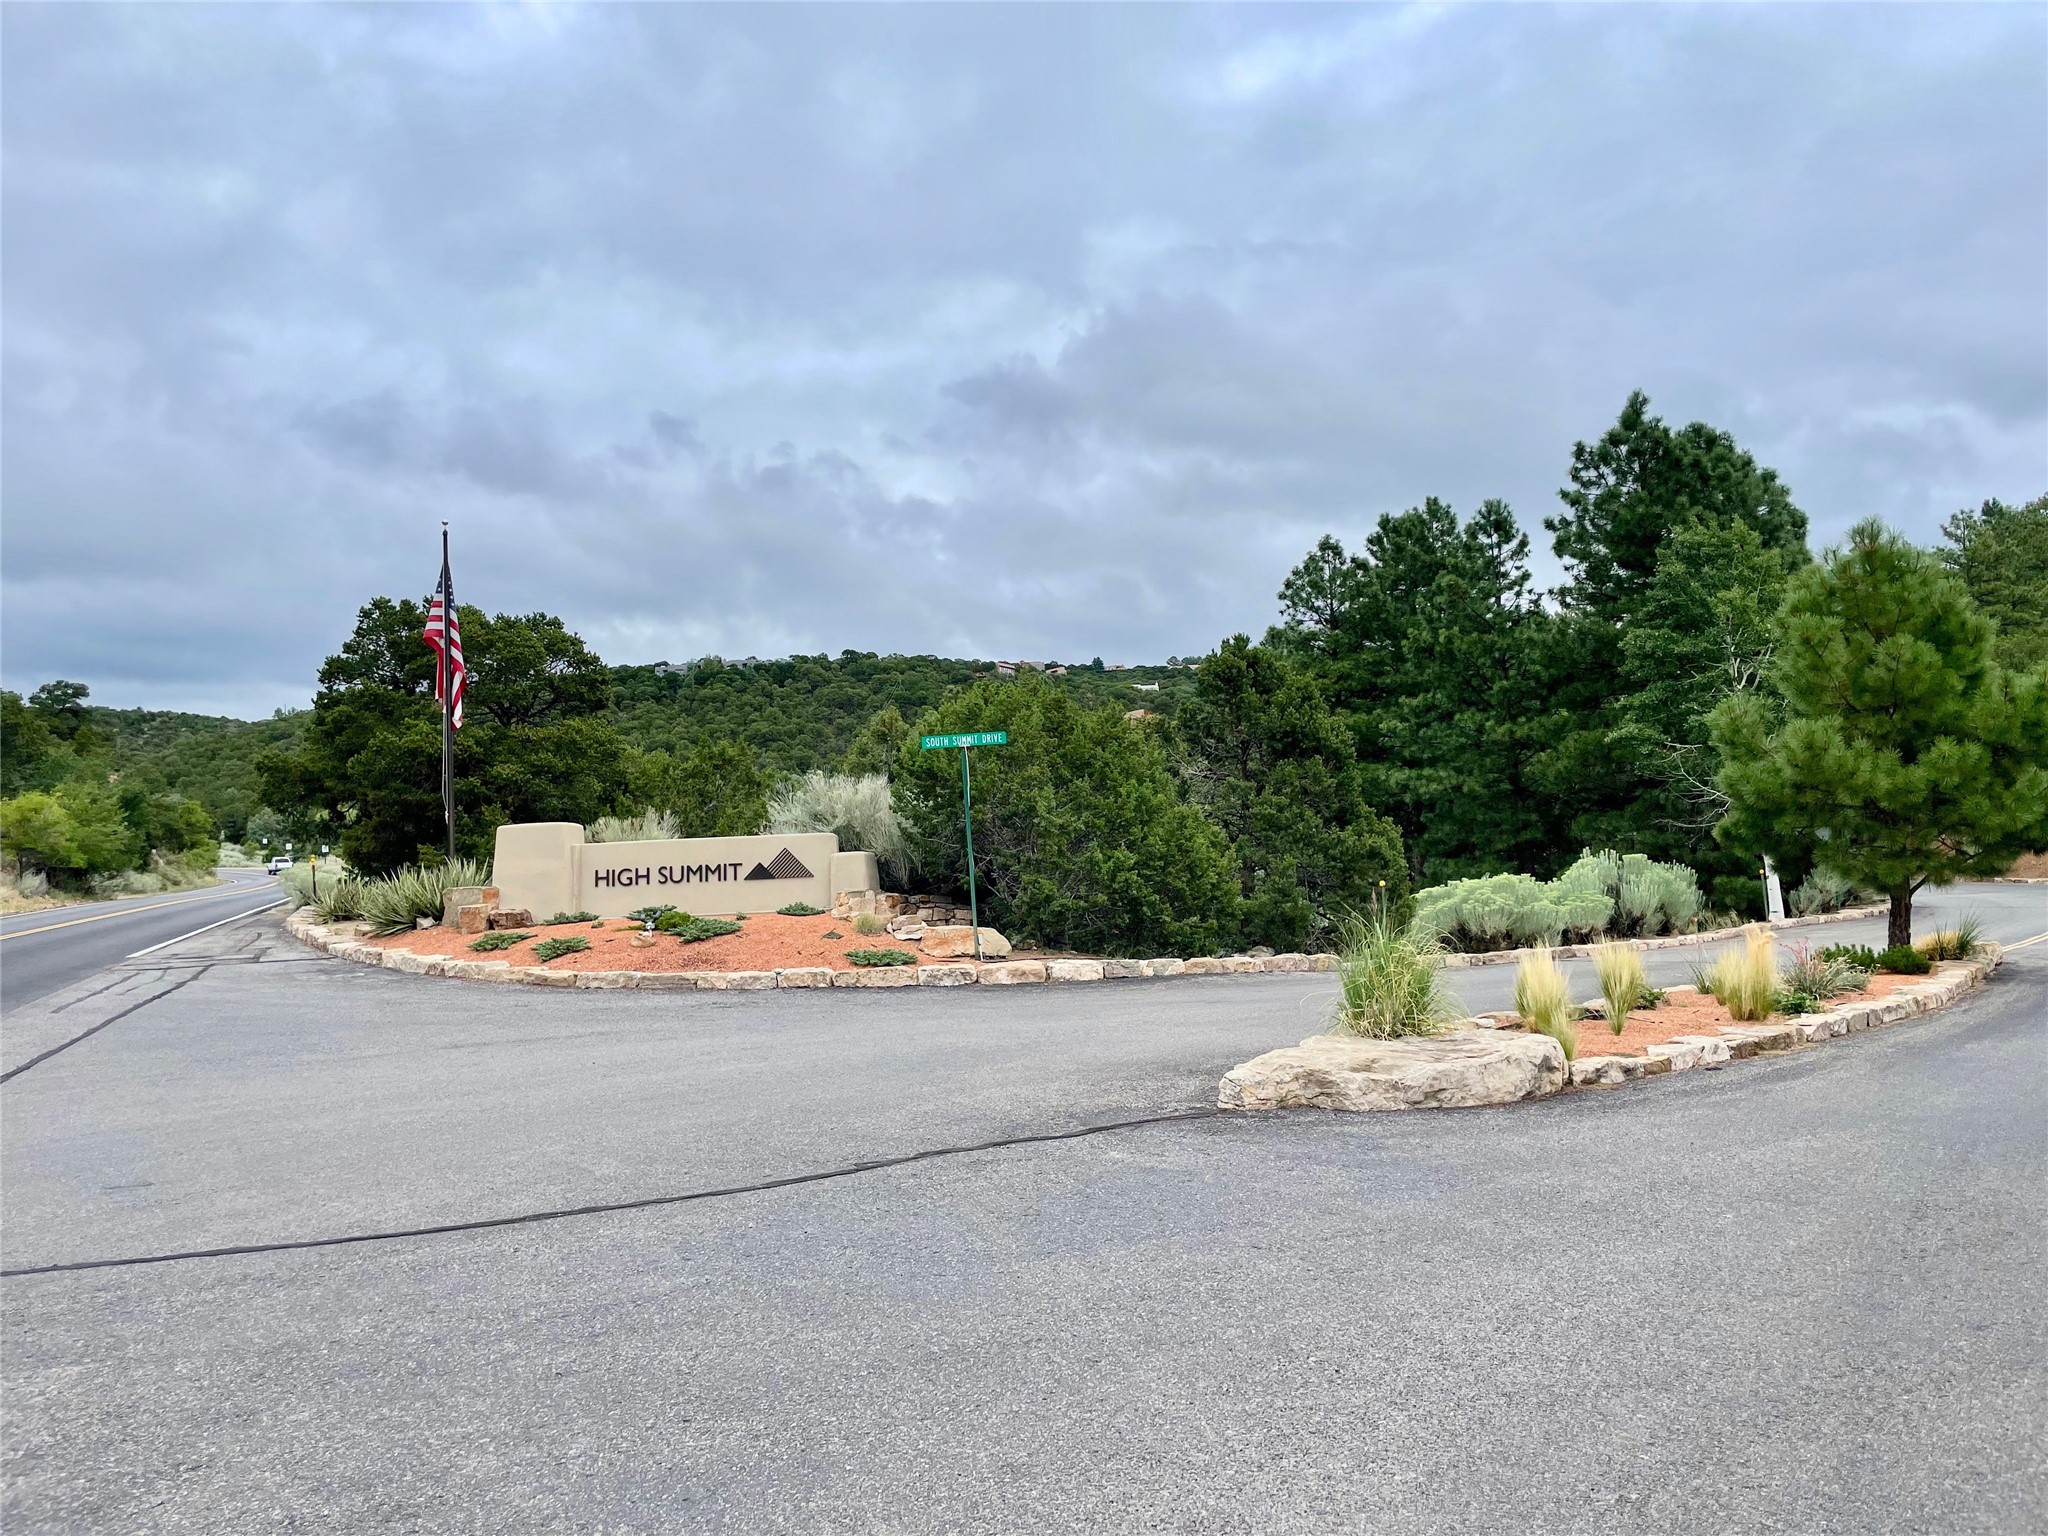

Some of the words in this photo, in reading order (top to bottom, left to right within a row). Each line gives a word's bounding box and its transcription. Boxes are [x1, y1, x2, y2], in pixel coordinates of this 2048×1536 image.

[925, 737, 949, 747] SOUTH
[952, 735, 978, 746] SUMMIT
[981, 733, 1003, 743] DRIVE
[594, 867, 650, 887] HIGH
[657, 862, 743, 884] SUMMIT
